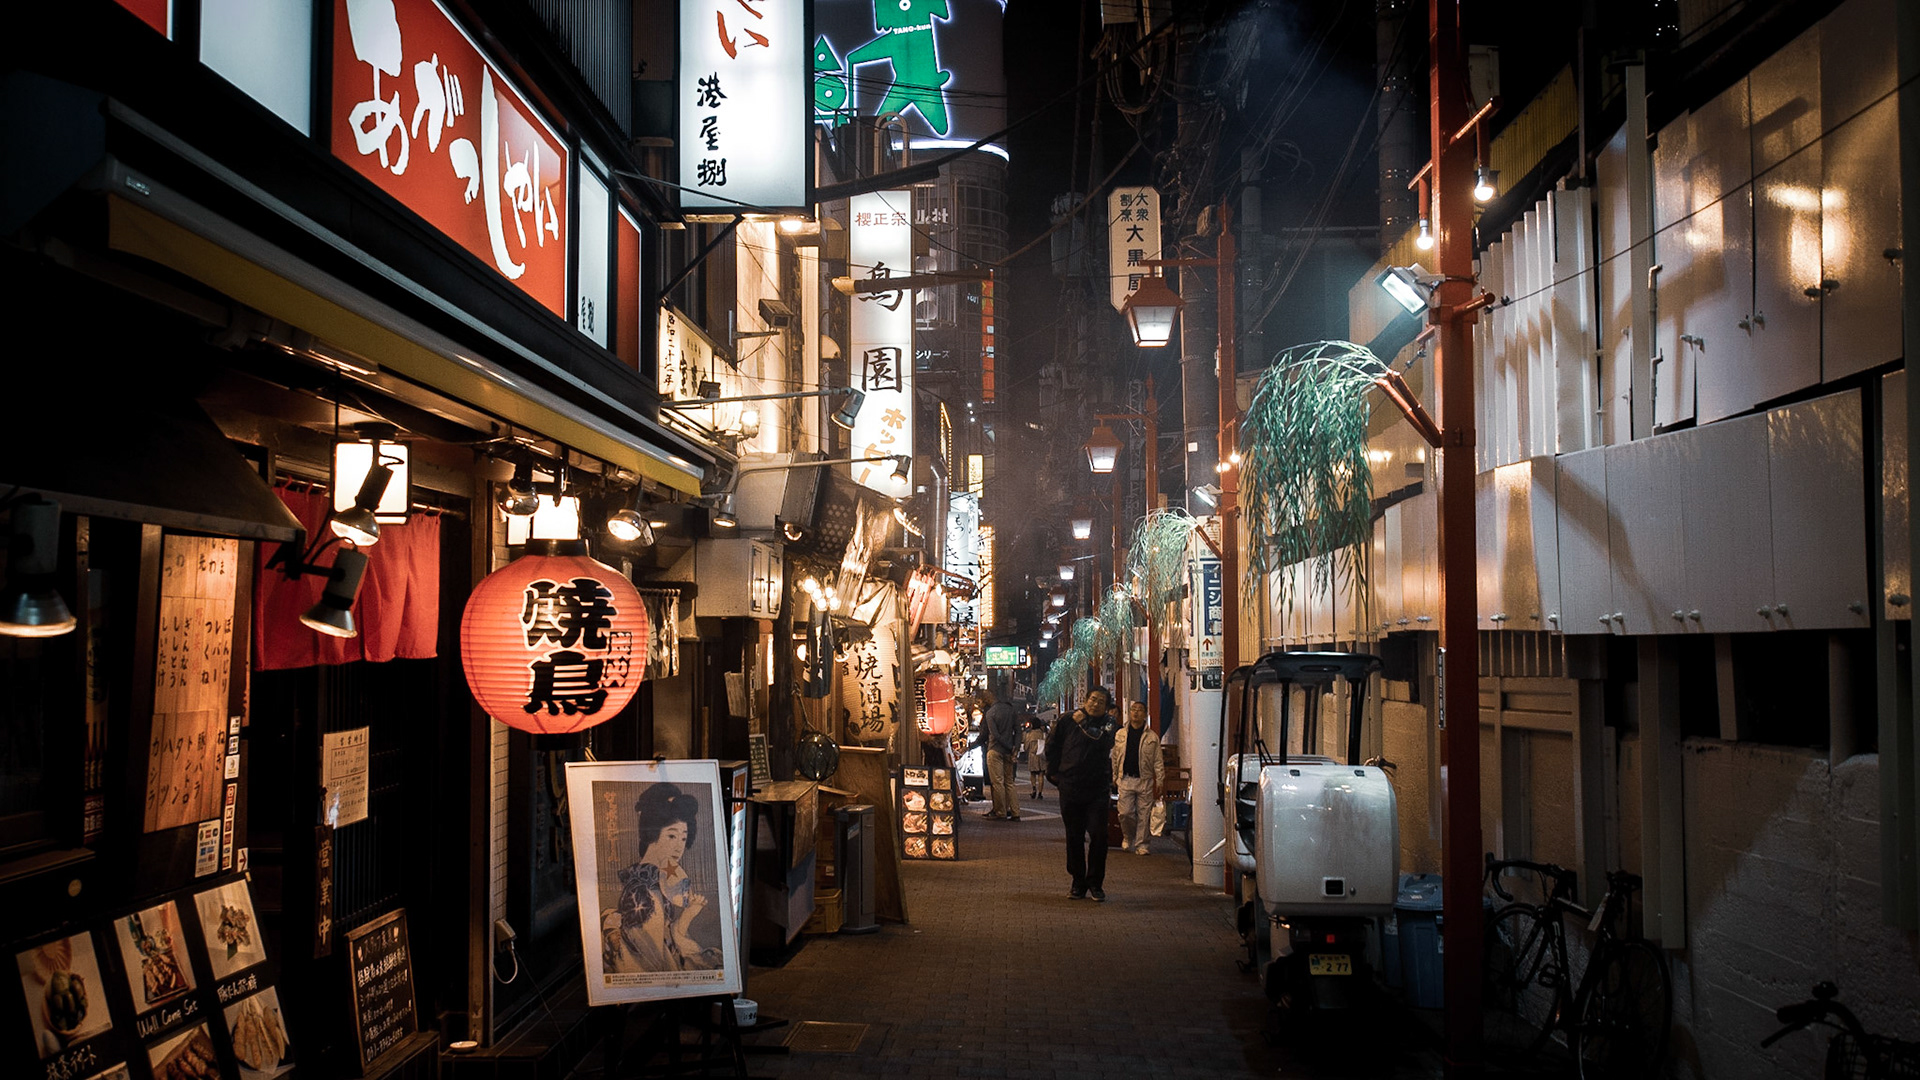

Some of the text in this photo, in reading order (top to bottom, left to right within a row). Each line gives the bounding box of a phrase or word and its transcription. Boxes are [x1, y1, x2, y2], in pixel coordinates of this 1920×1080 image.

[854, 211, 907, 227] 櫻正宗
[157, 616, 168, 687] しいたけ
[169, 616, 180, 688] ししとう
[179, 617, 192, 687] ぎんなん
[200, 621, 212, 684] つくね
[523, 579, 617, 715] 焼鳥
[148, 737, 160, 811] カシラ
[171, 737, 184, 805] タン
[318, 839, 333, 946] 営業中
[183, 998, 199, 1016] Set
